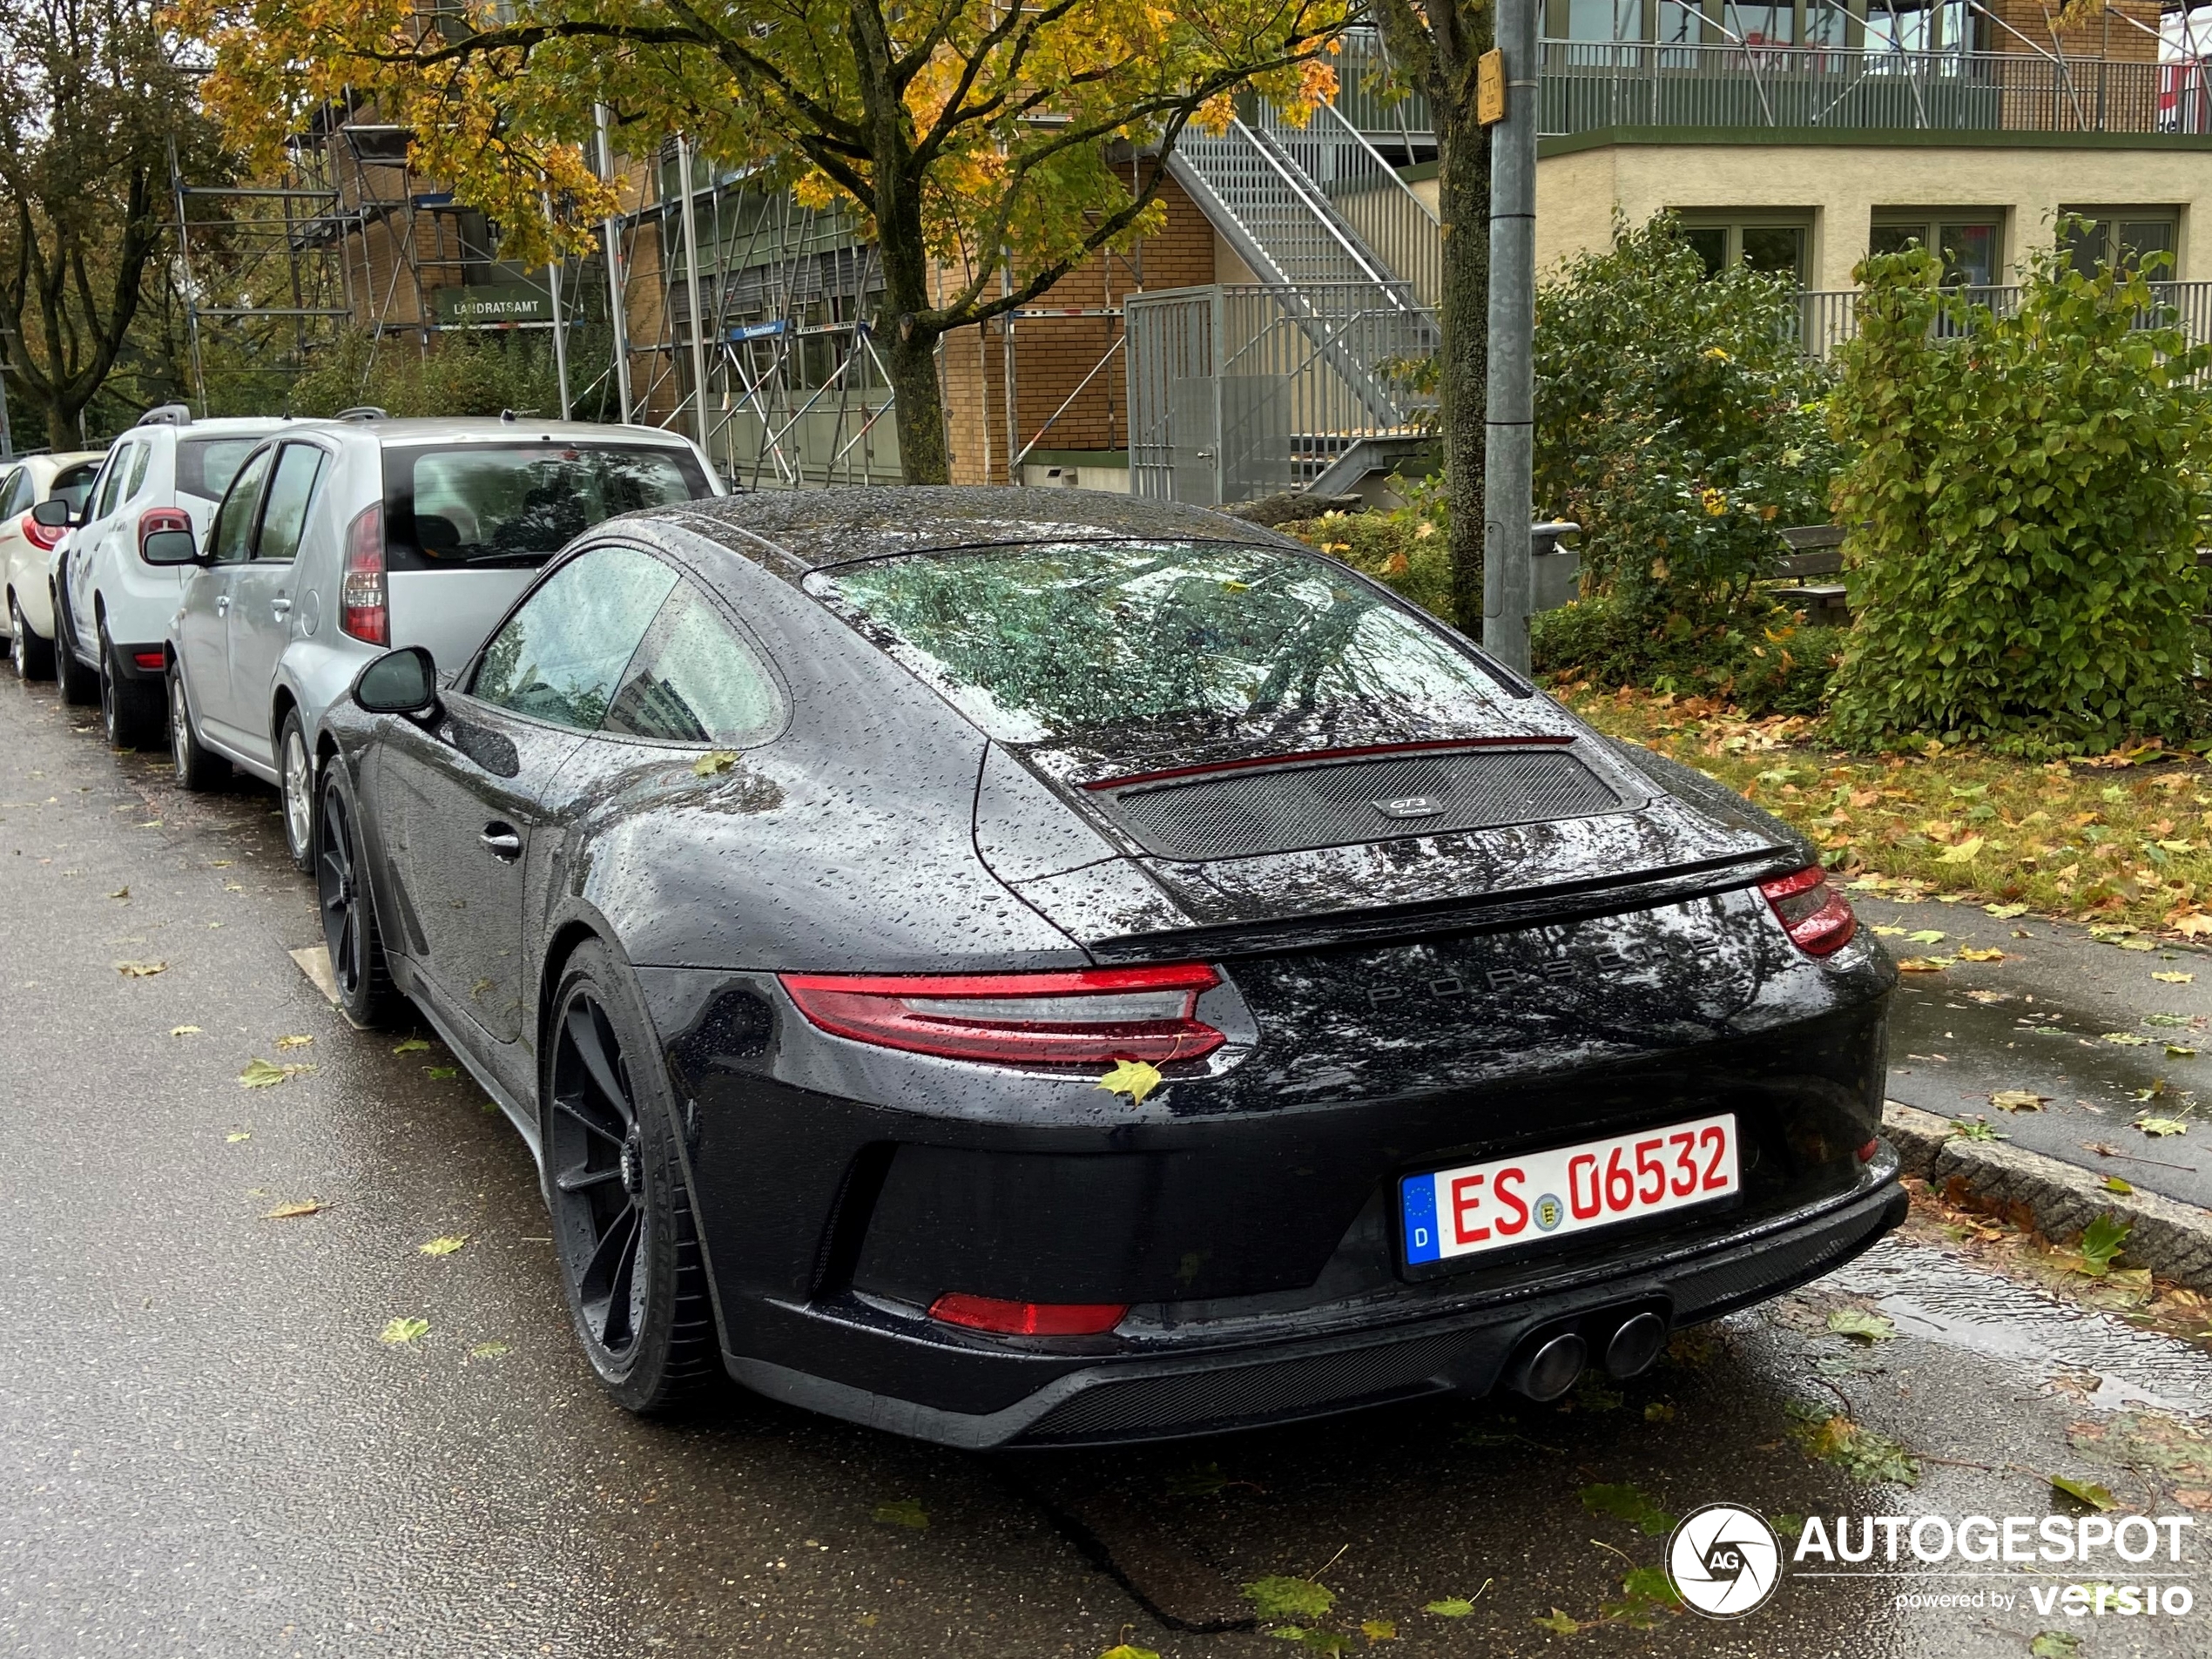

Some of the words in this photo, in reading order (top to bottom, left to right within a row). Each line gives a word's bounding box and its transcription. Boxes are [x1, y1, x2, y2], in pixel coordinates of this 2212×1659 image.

[1391, 799, 1426, 808] GT3
[1366, 937, 1719, 1008] PORSCHE
[1451, 1167, 1529, 1244] ES
[1568, 1125, 1729, 1220] 06532
[1414, 1227, 1429, 1248] D
